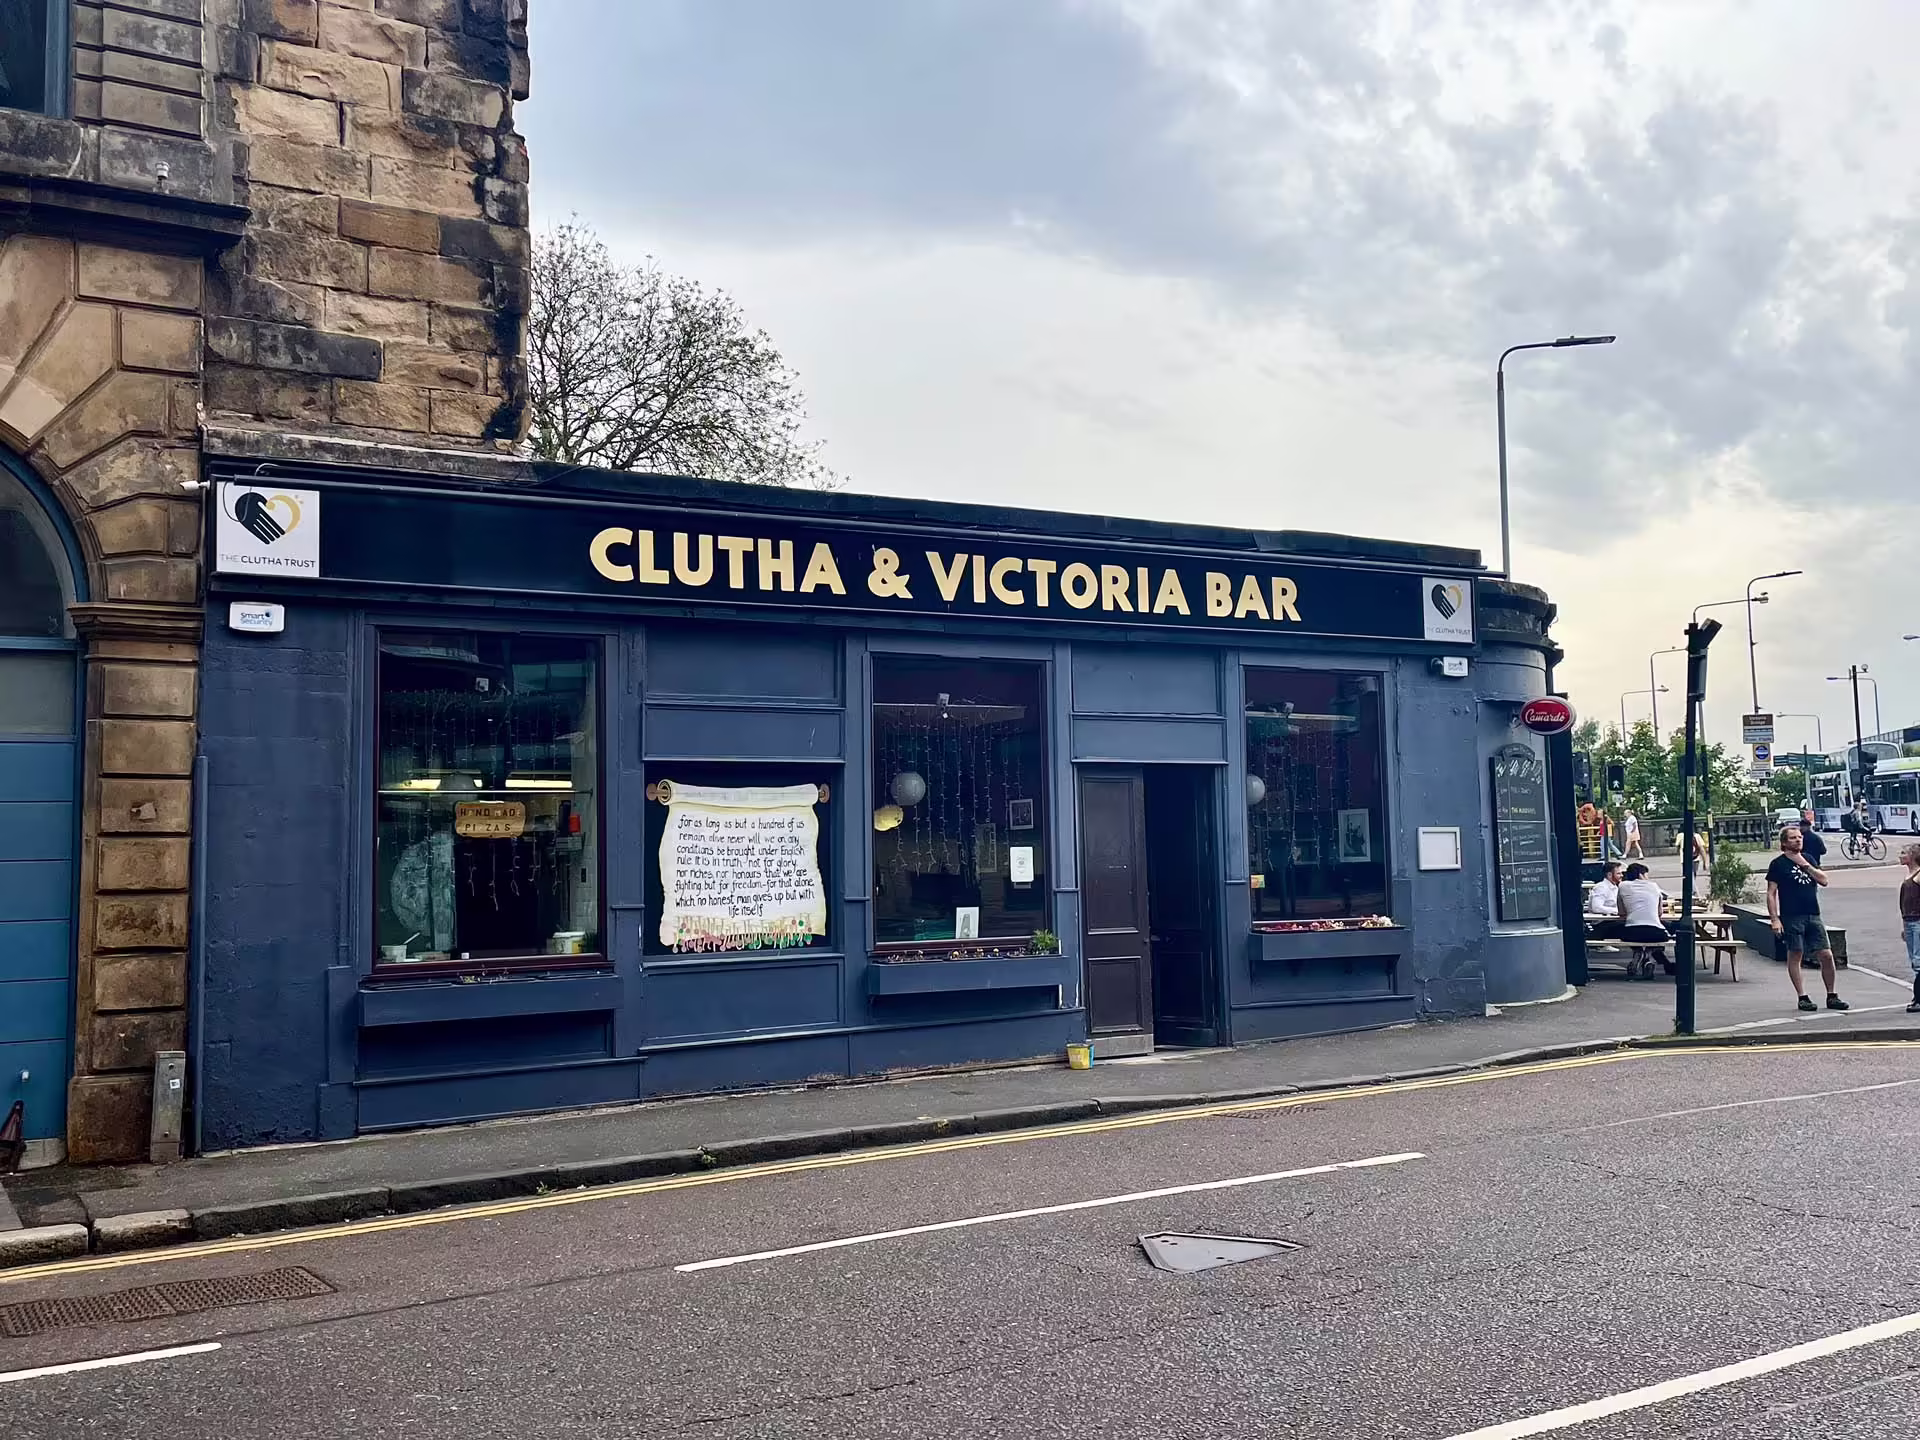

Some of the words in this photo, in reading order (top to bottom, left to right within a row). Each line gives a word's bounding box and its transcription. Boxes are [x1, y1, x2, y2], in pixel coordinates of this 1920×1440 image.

[219, 553, 240, 563] THE
[240, 555, 282, 566] CLUTHA
[284, 558, 316, 568] TRUST
[589, 527, 847, 595] CLUTHA
[867, 547, 914, 599] &
[925, 551, 1191, 616] VICTORIA
[1205, 571, 1302, 622] BAR
[465, 823, 511, 832] PIZAS
[694, 820, 703, 828] as
[706, 816, 720, 833] long
[724, 821, 732, 829] as
[735, 817, 747, 829] but
[751, 821, 756, 829] a
[759, 817, 785, 829] hundred
[788, 817, 795, 833] of
[796, 820, 805, 829] us
[679, 832, 706, 842] remain
[728, 835, 746, 844] never
[748, 831, 761, 845] will
[777, 836, 787, 844] on
[788, 835, 800, 848] any
[676, 844, 714, 856] conditions
[717, 846, 726, 856] be
[727, 844, 756, 864] brought
[758, 844, 779, 857] under
[781, 845, 806, 861] English
[702, 855, 710, 867] is
[712, 856, 720, 867] in
[748, 858, 762, 869] not
[763, 857, 775, 873] for
[676, 868, 688, 878] nor
[716, 869, 729, 879] nor
[732, 868, 761, 879] honours
[764, 868, 781, 878] that
[783, 869, 793, 878] we
[796, 868, 808, 877] are
[704, 879, 716, 890] but
[717, 879, 729, 895] for
[778, 877, 792, 889] that
[675, 894, 696, 908] which
[697, 896, 707, 907] no
[708, 893, 735, 907] honest
[736, 895, 752, 905] man
[752, 892, 773, 909] gives
[774, 892, 784, 906] up
[785, 889, 797, 901] but
[798, 887, 815, 901] with
[728, 904, 740, 919] life
[740, 903, 763, 917] itself
